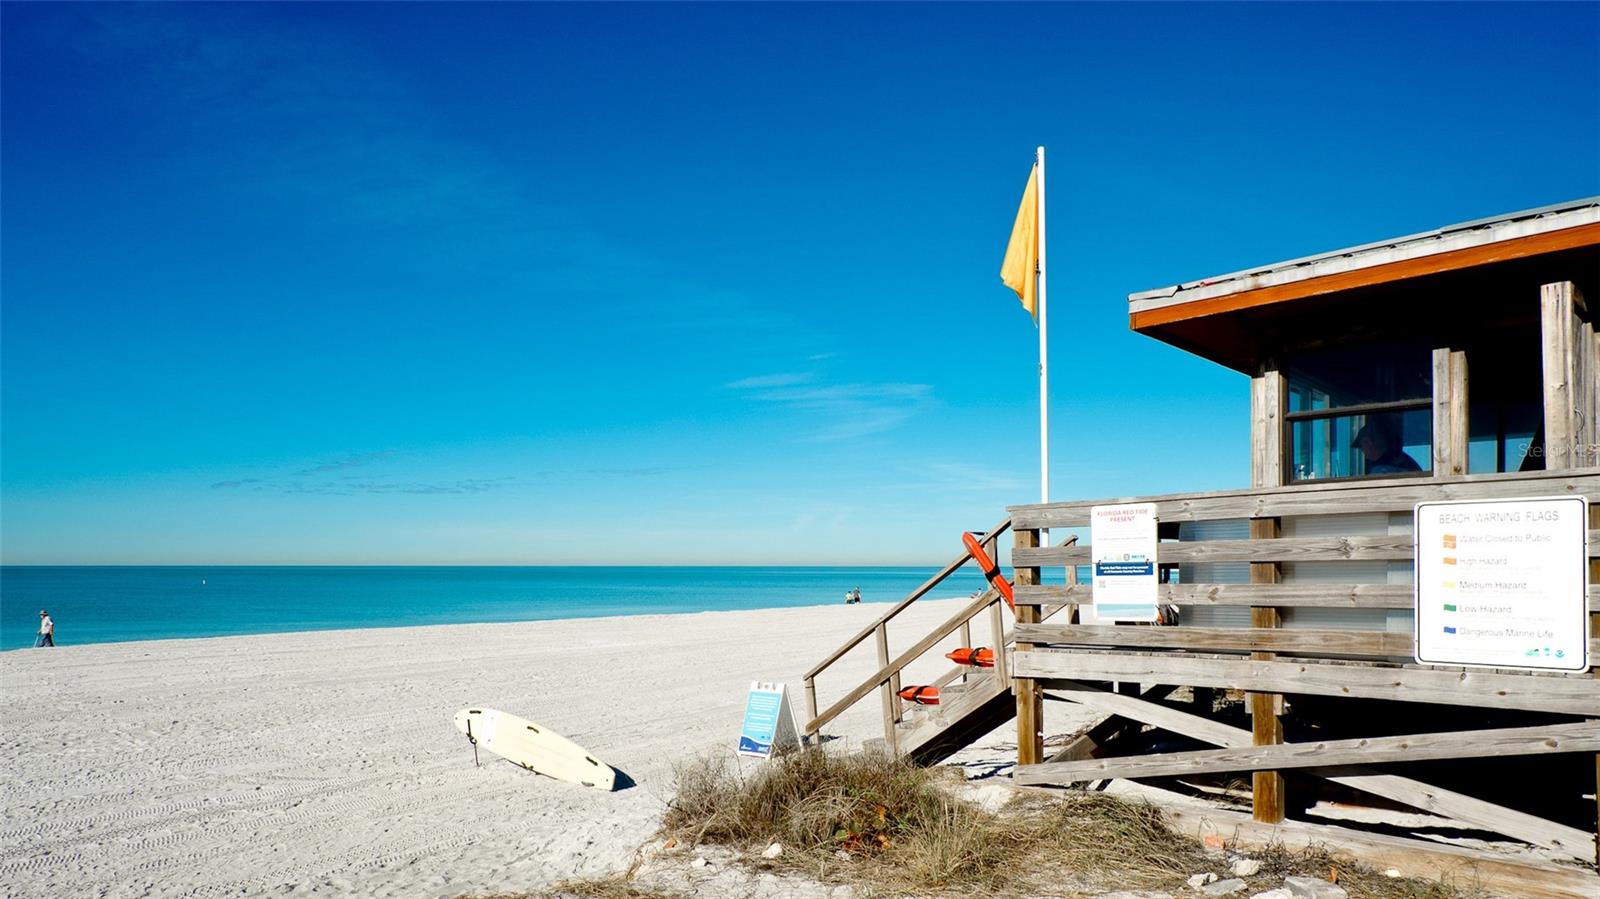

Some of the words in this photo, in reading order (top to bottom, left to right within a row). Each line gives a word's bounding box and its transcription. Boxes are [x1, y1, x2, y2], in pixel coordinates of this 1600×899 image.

[1439, 513, 1470, 524] BEACH
[1475, 511, 1521, 523] WARNING
[1526, 510, 1559, 522] FLAGS
[1459, 534, 1484, 543] Water
[1485, 534, 1513, 543] Closed
[1514, 534, 1523, 543] to
[1525, 533, 1552, 543] Public
[1459, 556, 1477, 567] High
[1479, 556, 1508, 566] Hazard
[1459, 580, 1493, 590] Medium
[1495, 581, 1527, 590] Hazard
[1459, 604, 1477, 613] Low
[1480, 605, 1512, 614] Hazard
[1459, 626, 1504, 638] Dangerous
[1506, 628, 1535, 638] Marine
[1537, 629, 1554, 639] Life
